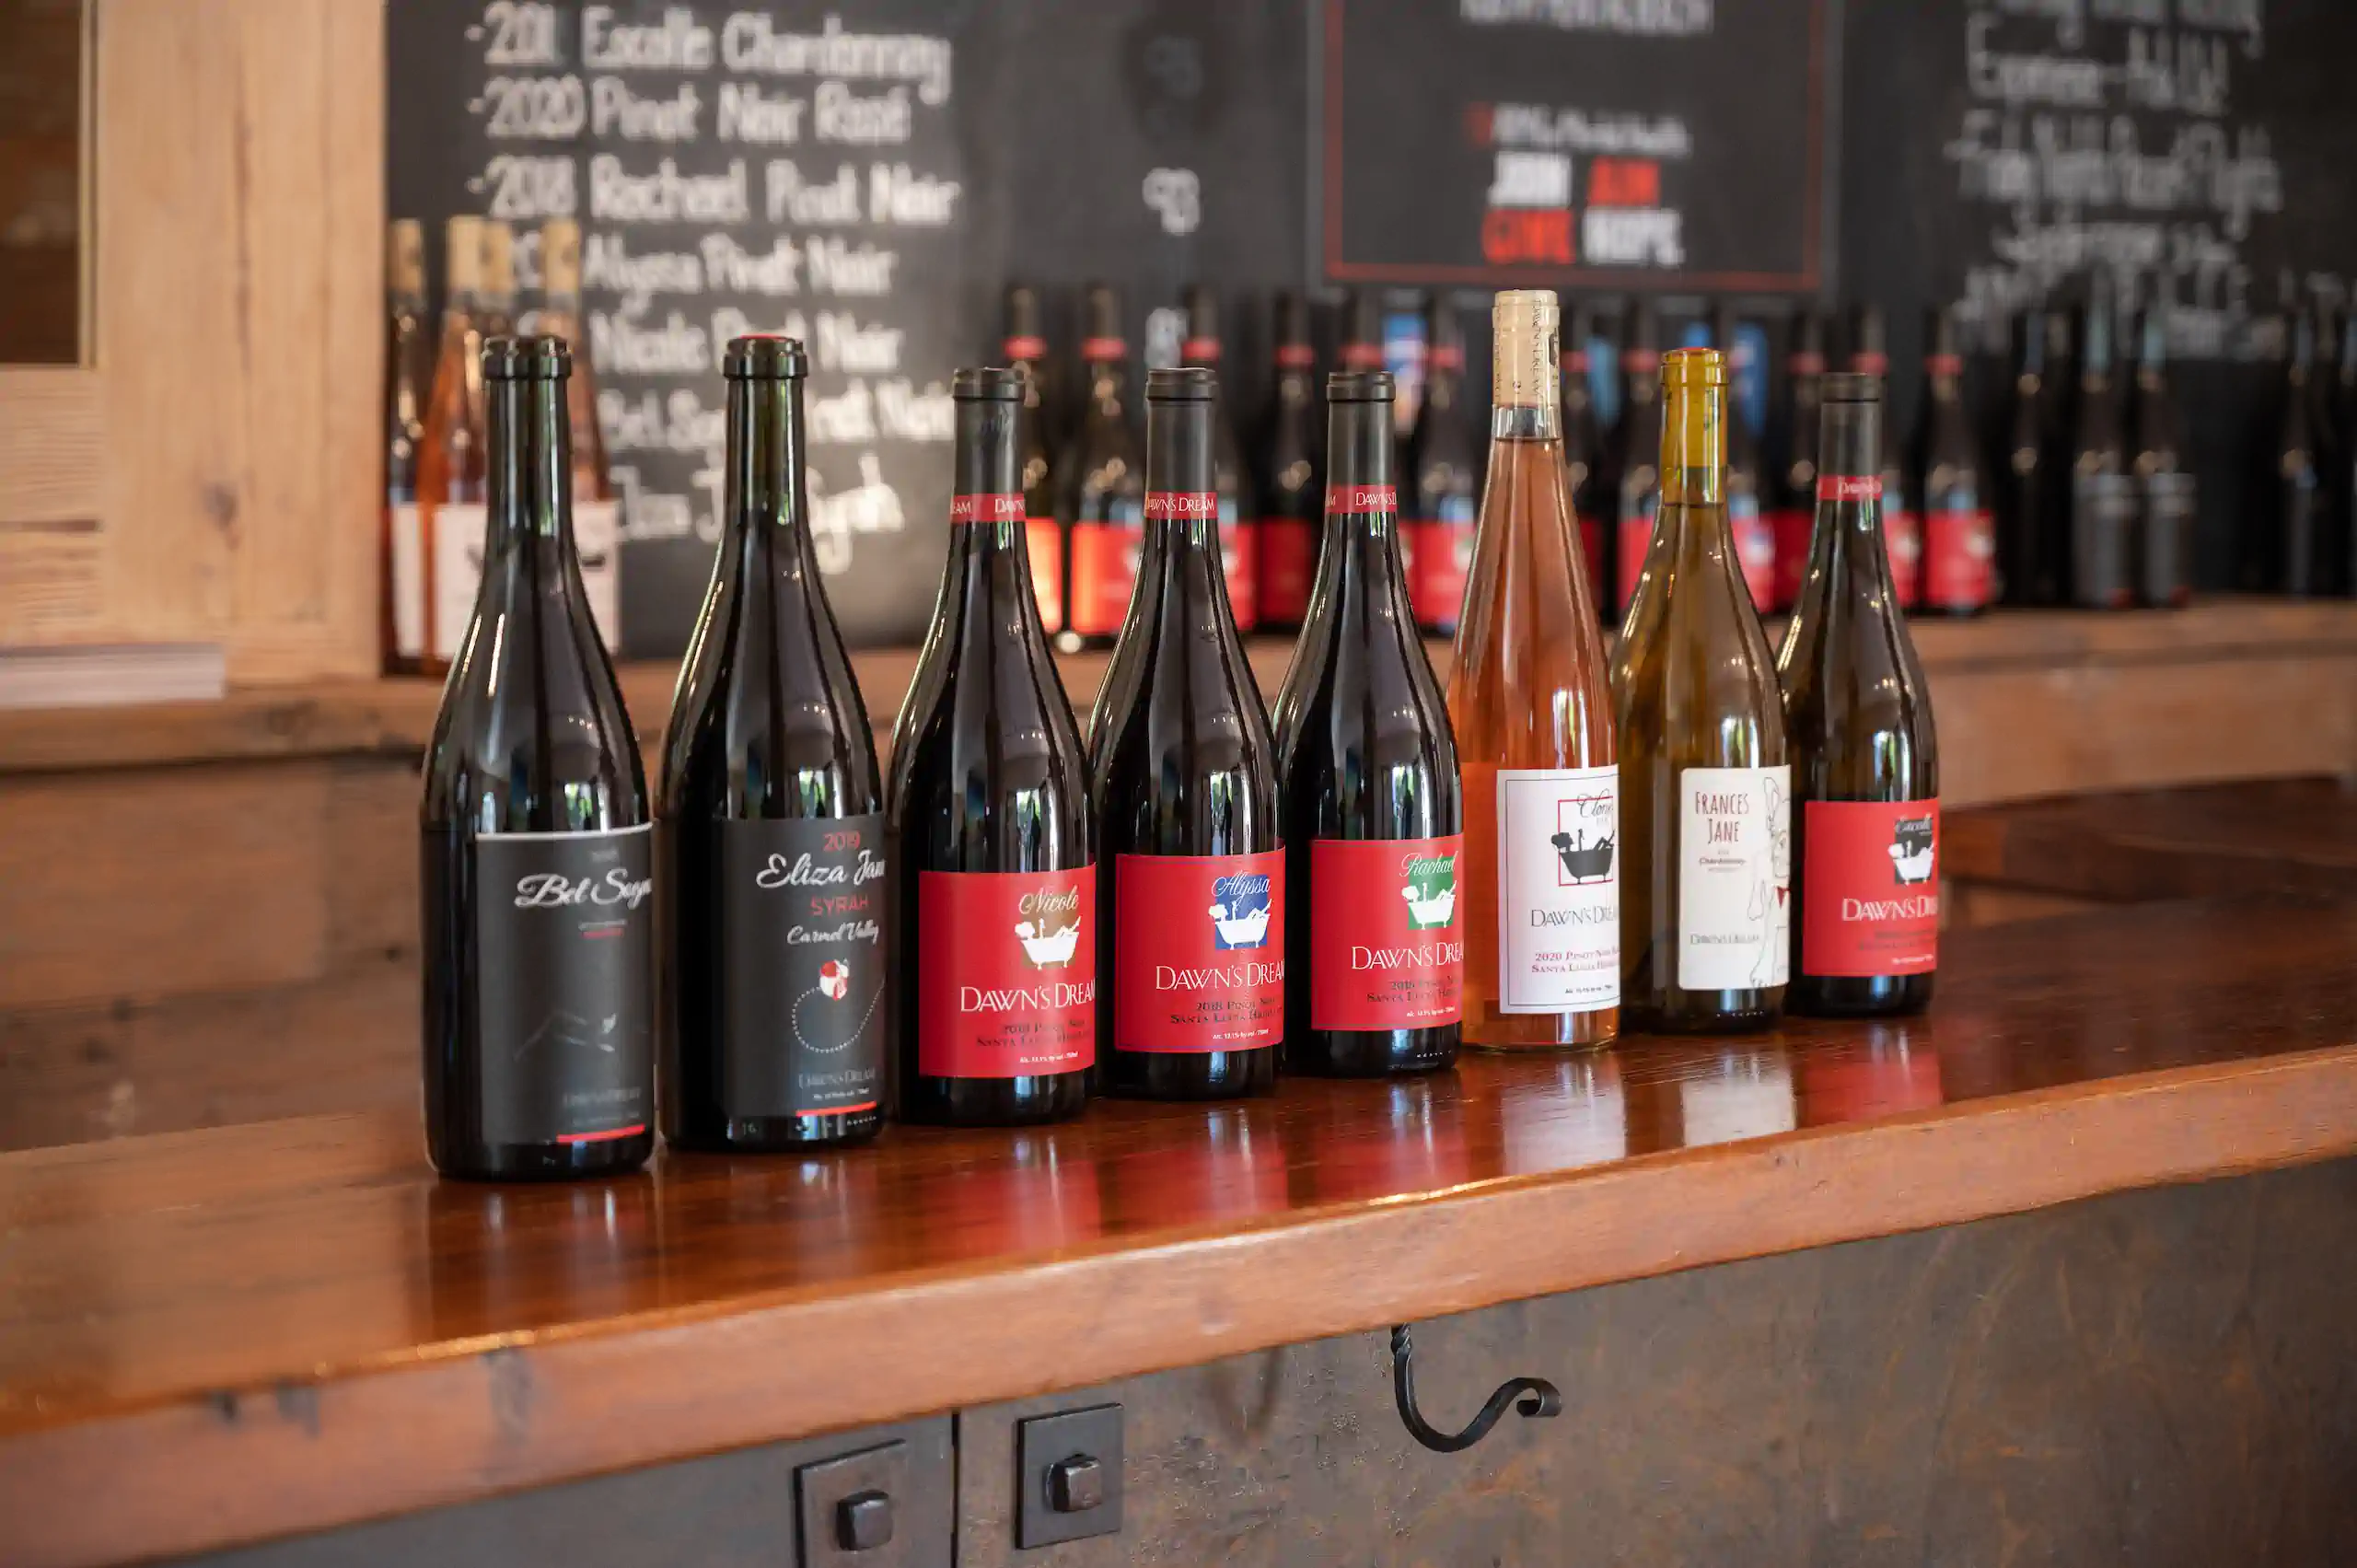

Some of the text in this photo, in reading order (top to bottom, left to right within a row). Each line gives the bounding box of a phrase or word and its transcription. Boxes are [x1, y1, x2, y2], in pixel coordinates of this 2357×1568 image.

[1178, 496, 1215, 512] DREAM
[1694, 791, 1749, 816] FRANCES
[1707, 818, 1740, 845] JANE
[755, 853, 848, 889] Eliza
[1018, 885, 1081, 915] Nicole
[1211, 869, 1271, 907] Alyssa
[809, 893, 870, 917] SYRAH
[1351, 943, 1434, 970] DAWN'S
[1155, 964, 1243, 991] DAWN'S
[960, 983, 1051, 1013] DAWN'S
